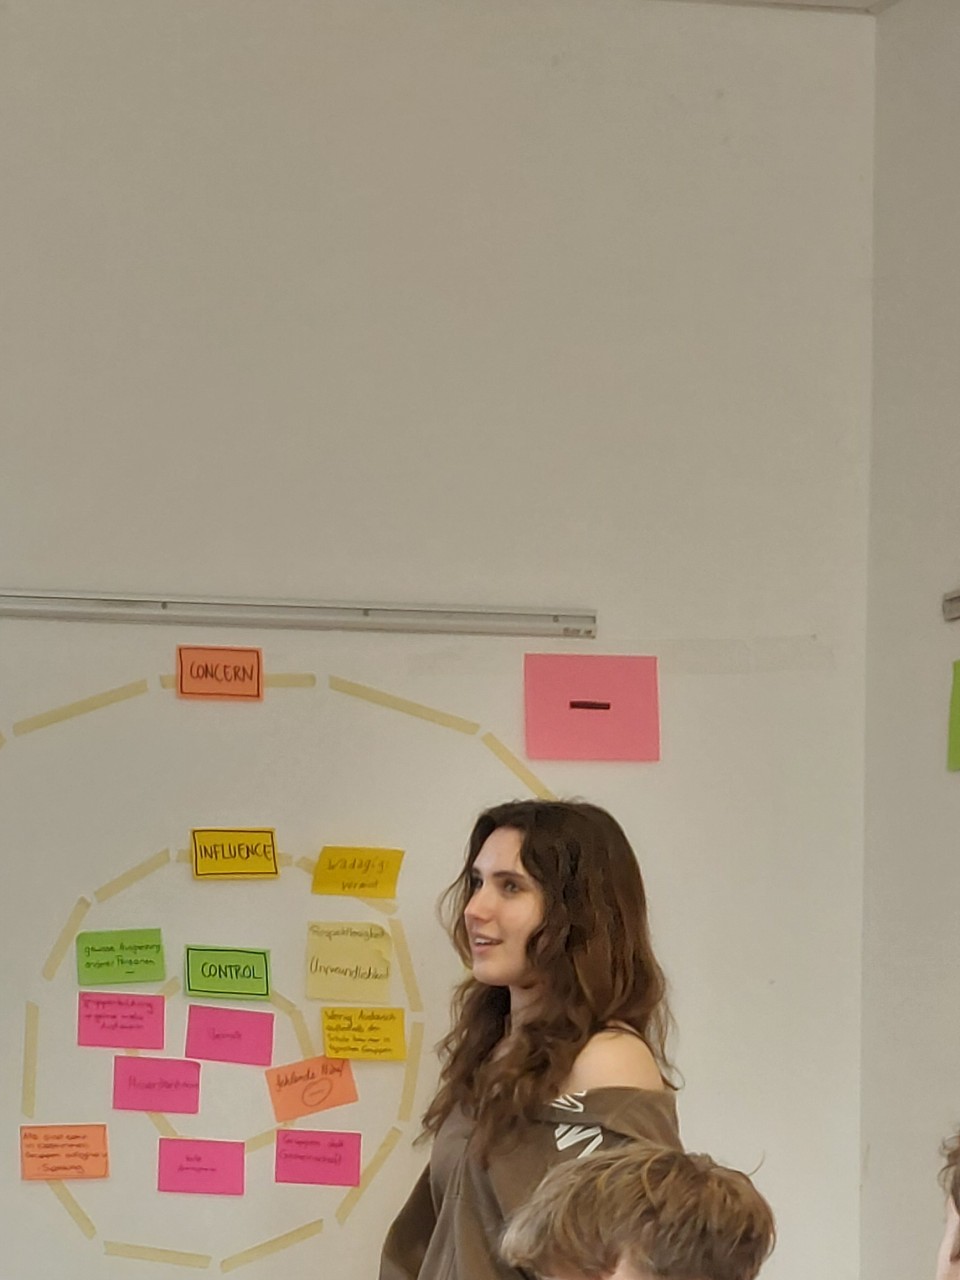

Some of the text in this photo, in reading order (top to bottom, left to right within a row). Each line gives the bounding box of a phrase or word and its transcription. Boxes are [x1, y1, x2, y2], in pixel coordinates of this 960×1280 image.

[190, 661, 254, 683] CONCERN
[199, 843, 273, 861] INFLUENCE
[201, 961, 263, 980] CONTROL
